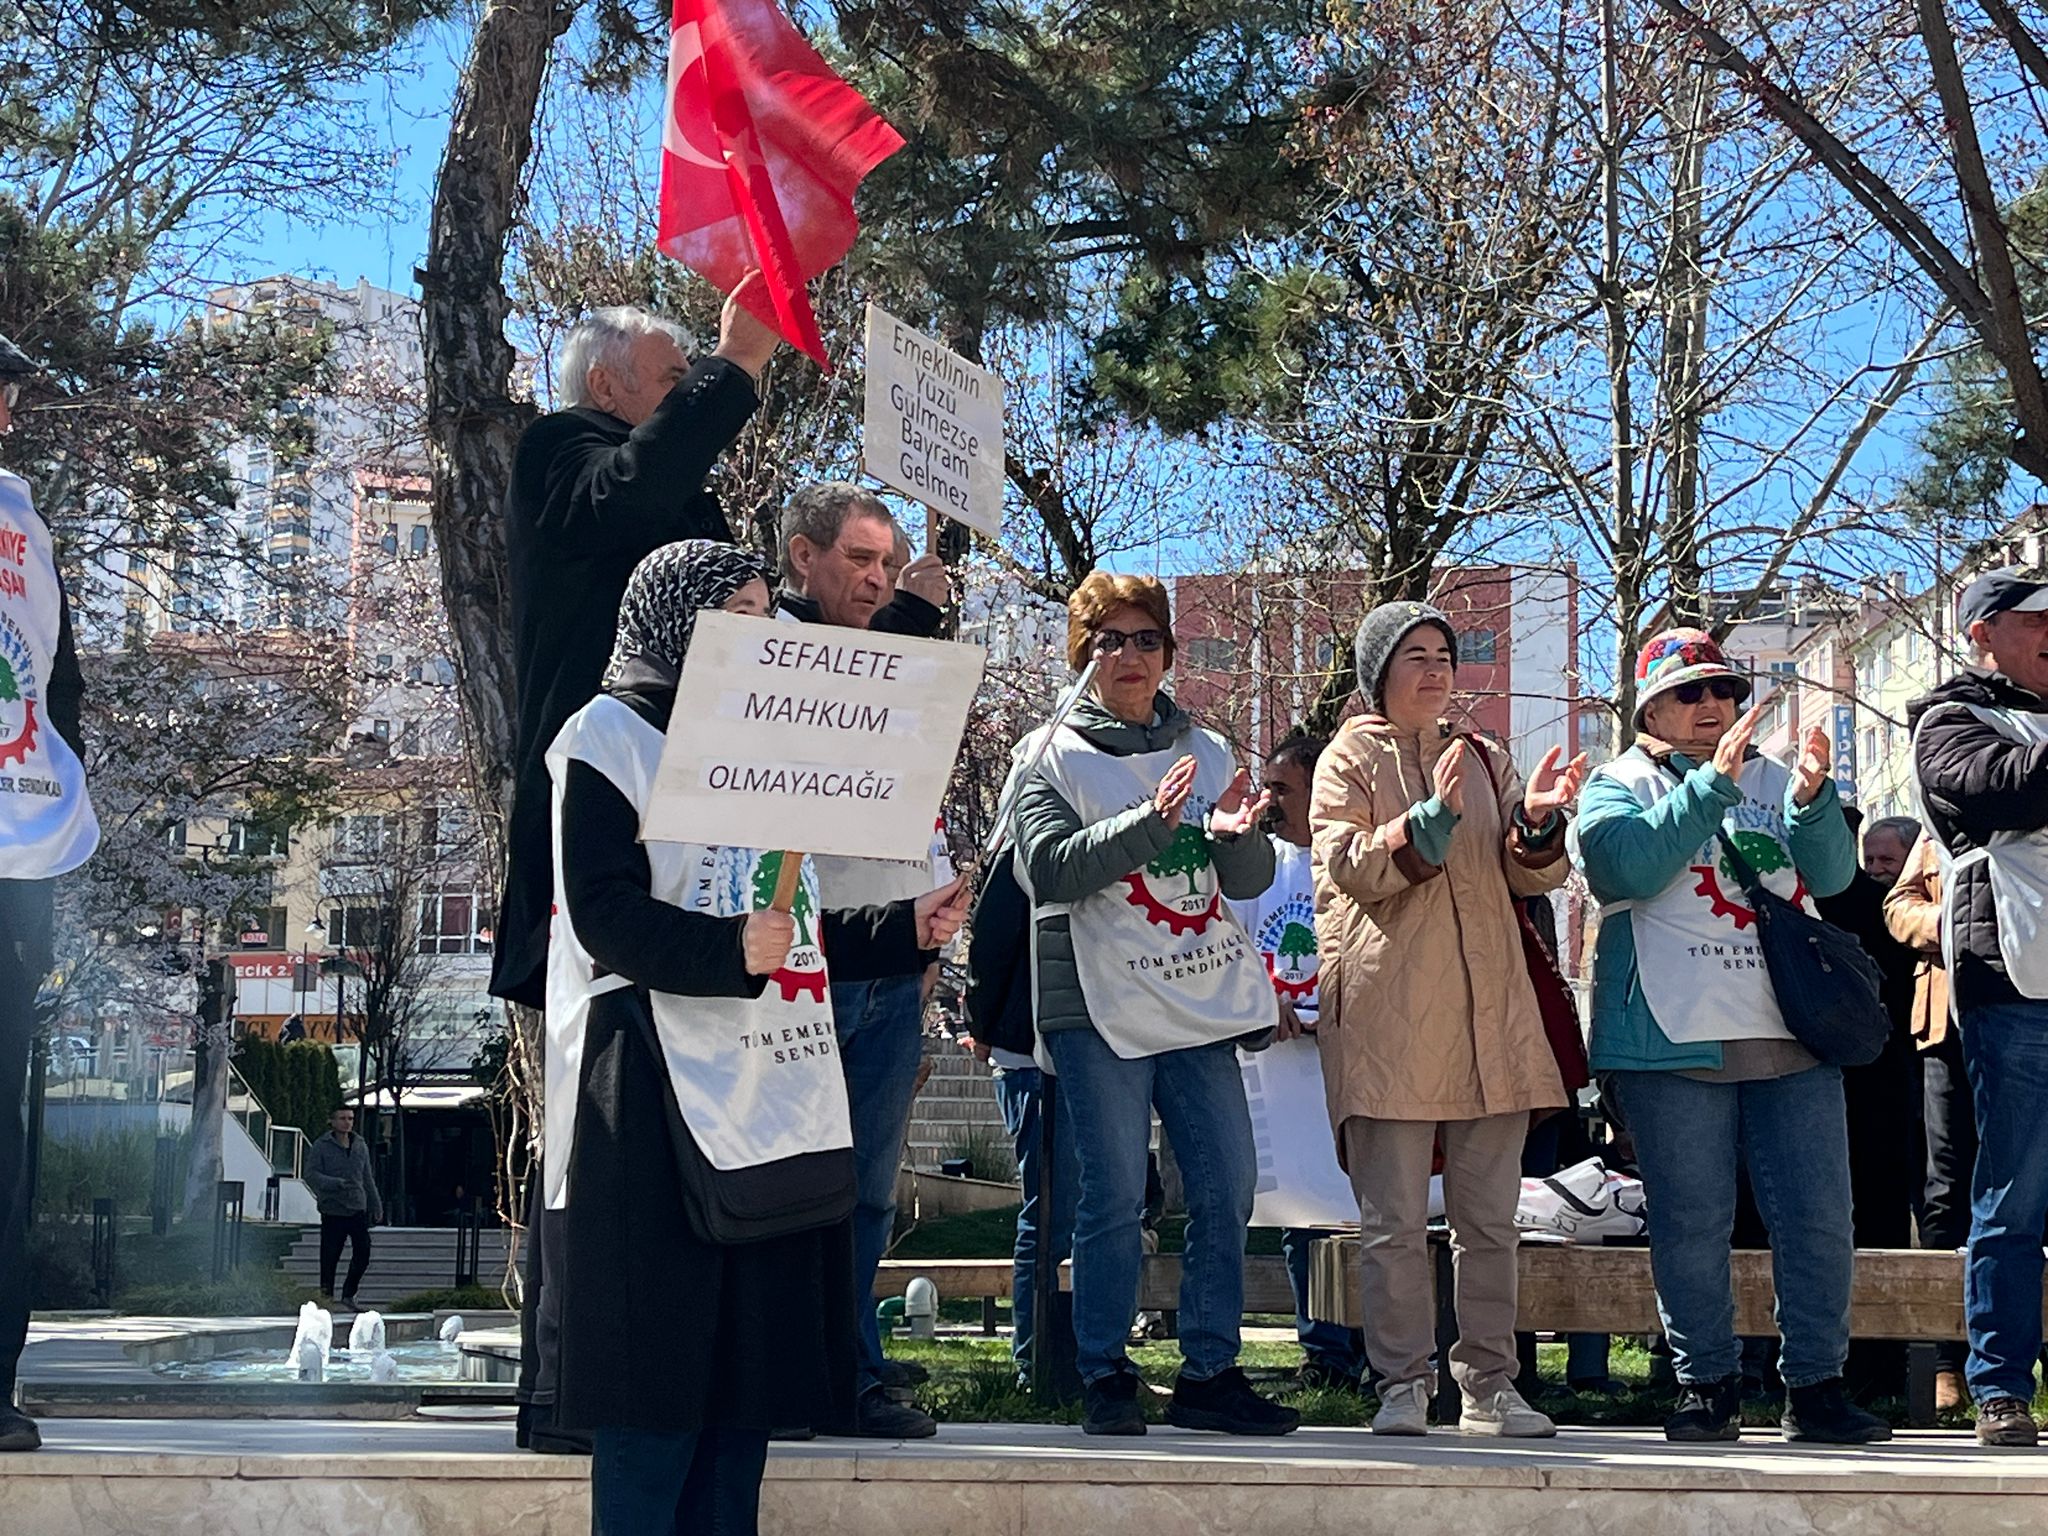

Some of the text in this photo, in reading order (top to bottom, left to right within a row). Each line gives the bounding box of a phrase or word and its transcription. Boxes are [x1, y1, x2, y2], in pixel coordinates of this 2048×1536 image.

[893, 324, 980, 399] Emeklinin
[914, 367, 957, 415] Yüzü
[890, 383, 979, 457] Gülmezse
[901, 417, 970, 480] Bayram
[900, 452, 970, 513] Gelmez
[759, 638, 903, 681] SEFALETE
[744, 692, 889, 734] MAHKUM
[708, 764, 895, 801] OLMAYACAĞIZ
[1181, 898, 1207, 912] 2017
[1687, 943, 1724, 957] TÜM
[1285, 972, 1304, 980] 2017
